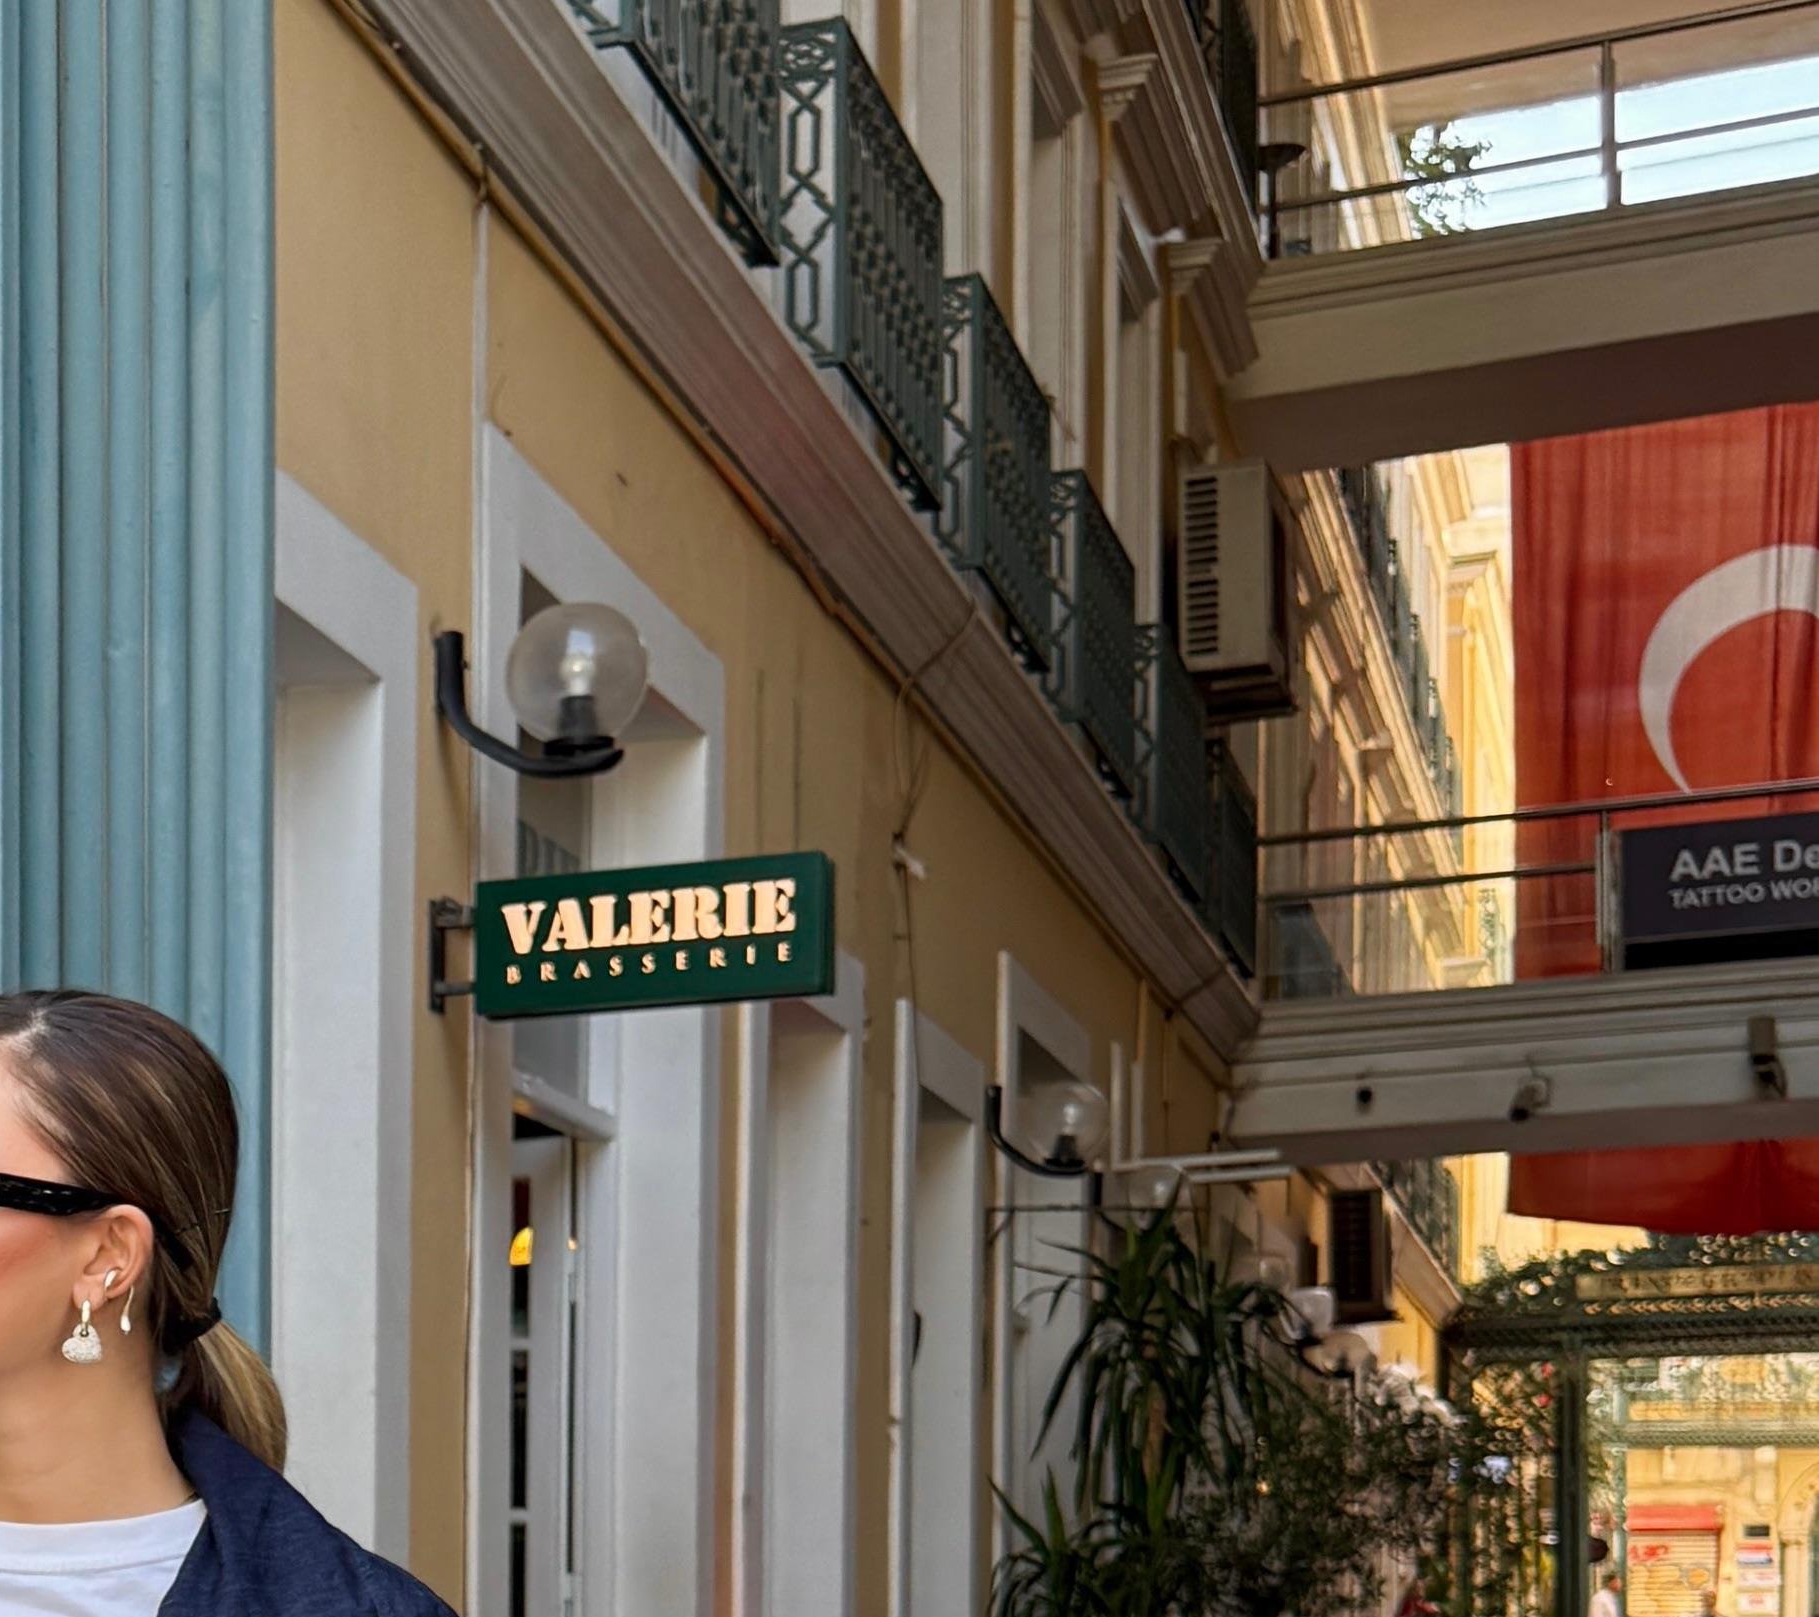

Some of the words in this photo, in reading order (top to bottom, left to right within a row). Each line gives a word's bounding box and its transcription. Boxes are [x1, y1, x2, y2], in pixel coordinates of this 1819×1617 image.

[1669, 842, 1761, 882] AAE
[500, 877, 797, 955] VALERIE
[1667, 881, 1766, 909] TATTOO
[505, 940, 794, 985] BRASSERIE
